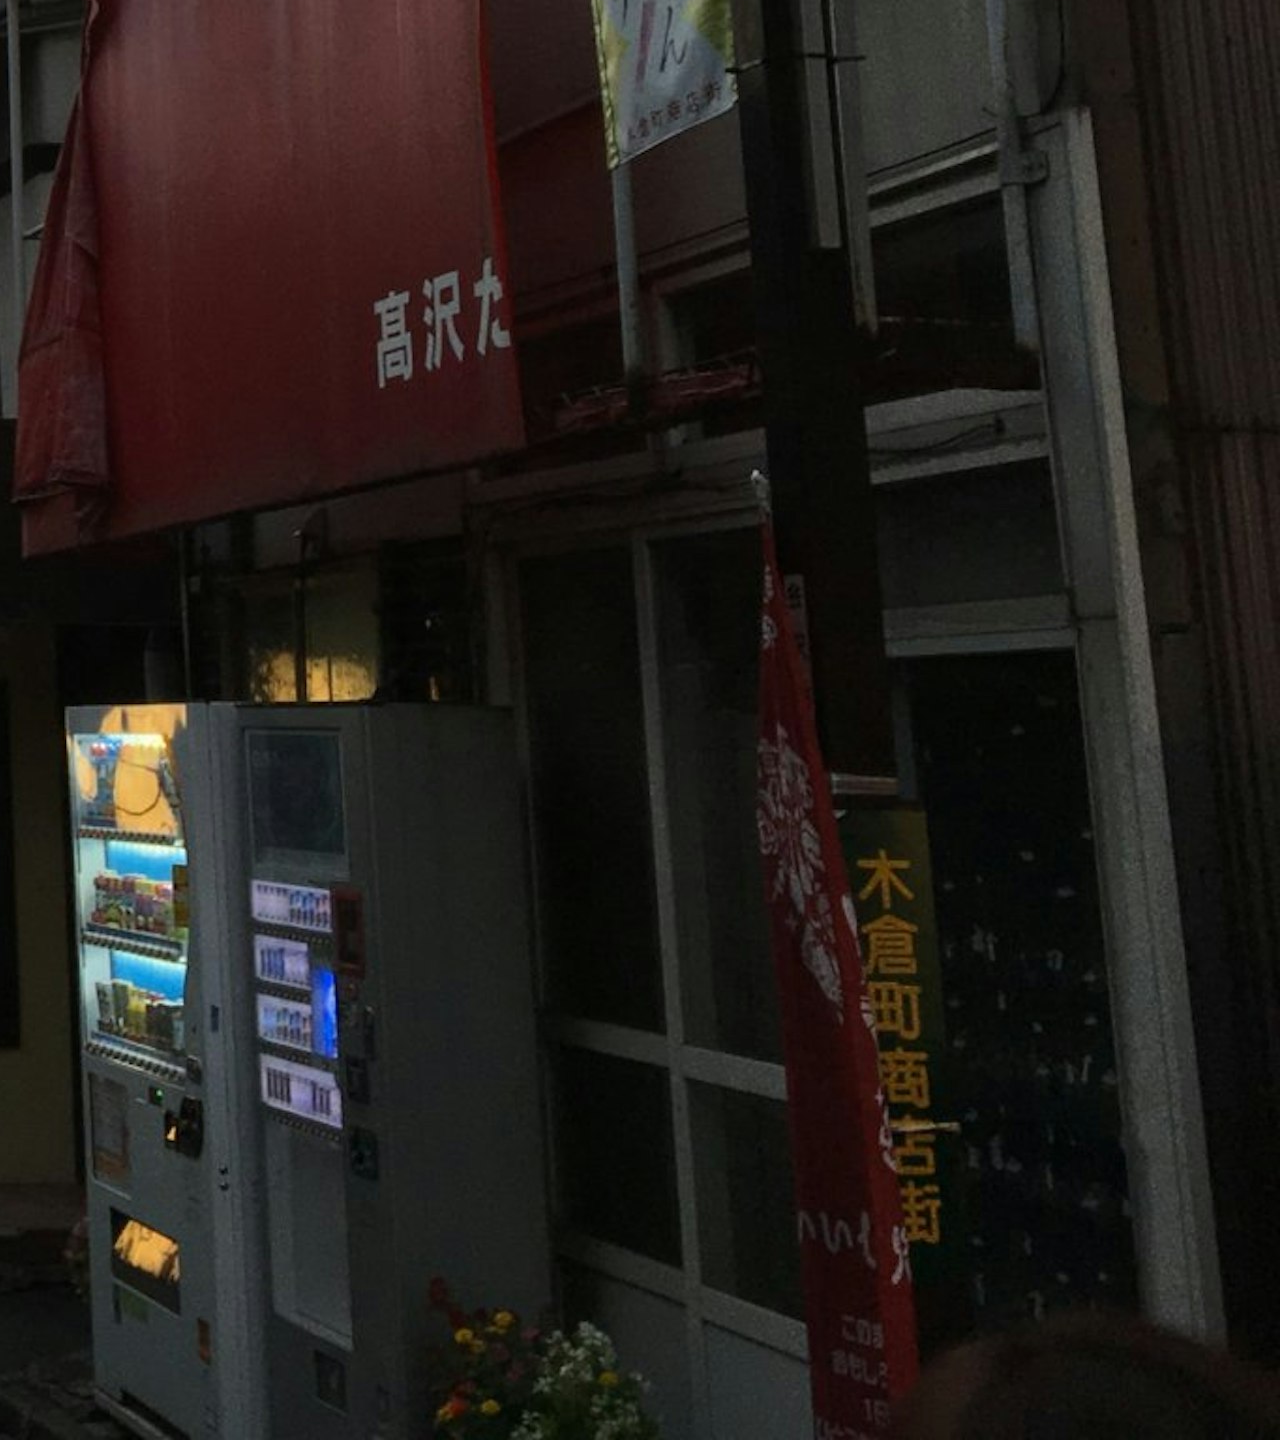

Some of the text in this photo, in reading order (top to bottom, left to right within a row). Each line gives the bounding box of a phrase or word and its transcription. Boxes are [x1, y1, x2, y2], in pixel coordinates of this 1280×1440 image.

[856, 847, 942, 1246] 木倉町商店街
